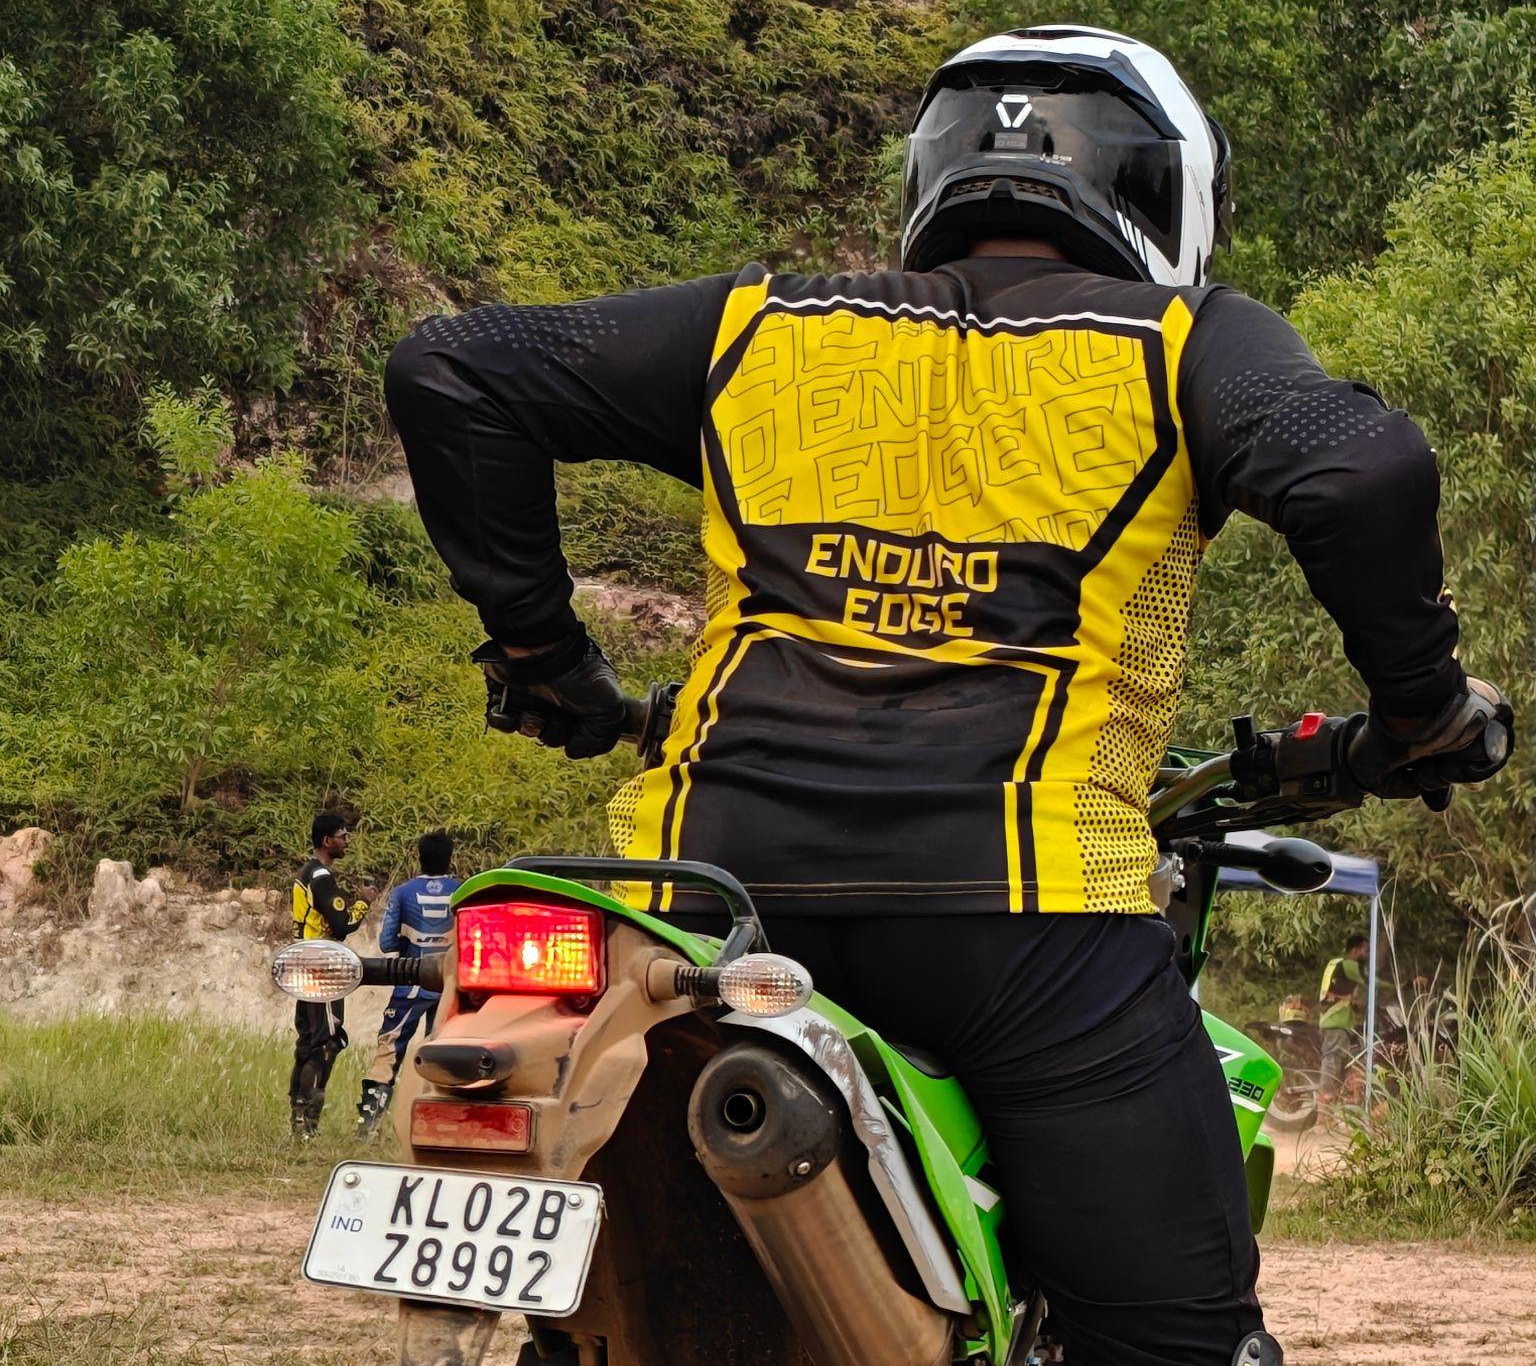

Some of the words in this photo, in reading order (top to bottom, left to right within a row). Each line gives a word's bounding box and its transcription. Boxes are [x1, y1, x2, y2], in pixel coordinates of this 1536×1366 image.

[803, 533, 1000, 594] ENDURO
[841, 586, 975, 638] EDGE
[1228, 1076, 1265, 1102] 230
[330, 1214, 364, 1233] IND
[389, 1175, 567, 1241] KL02B
[373, 1232, 553, 1303] Z8992
